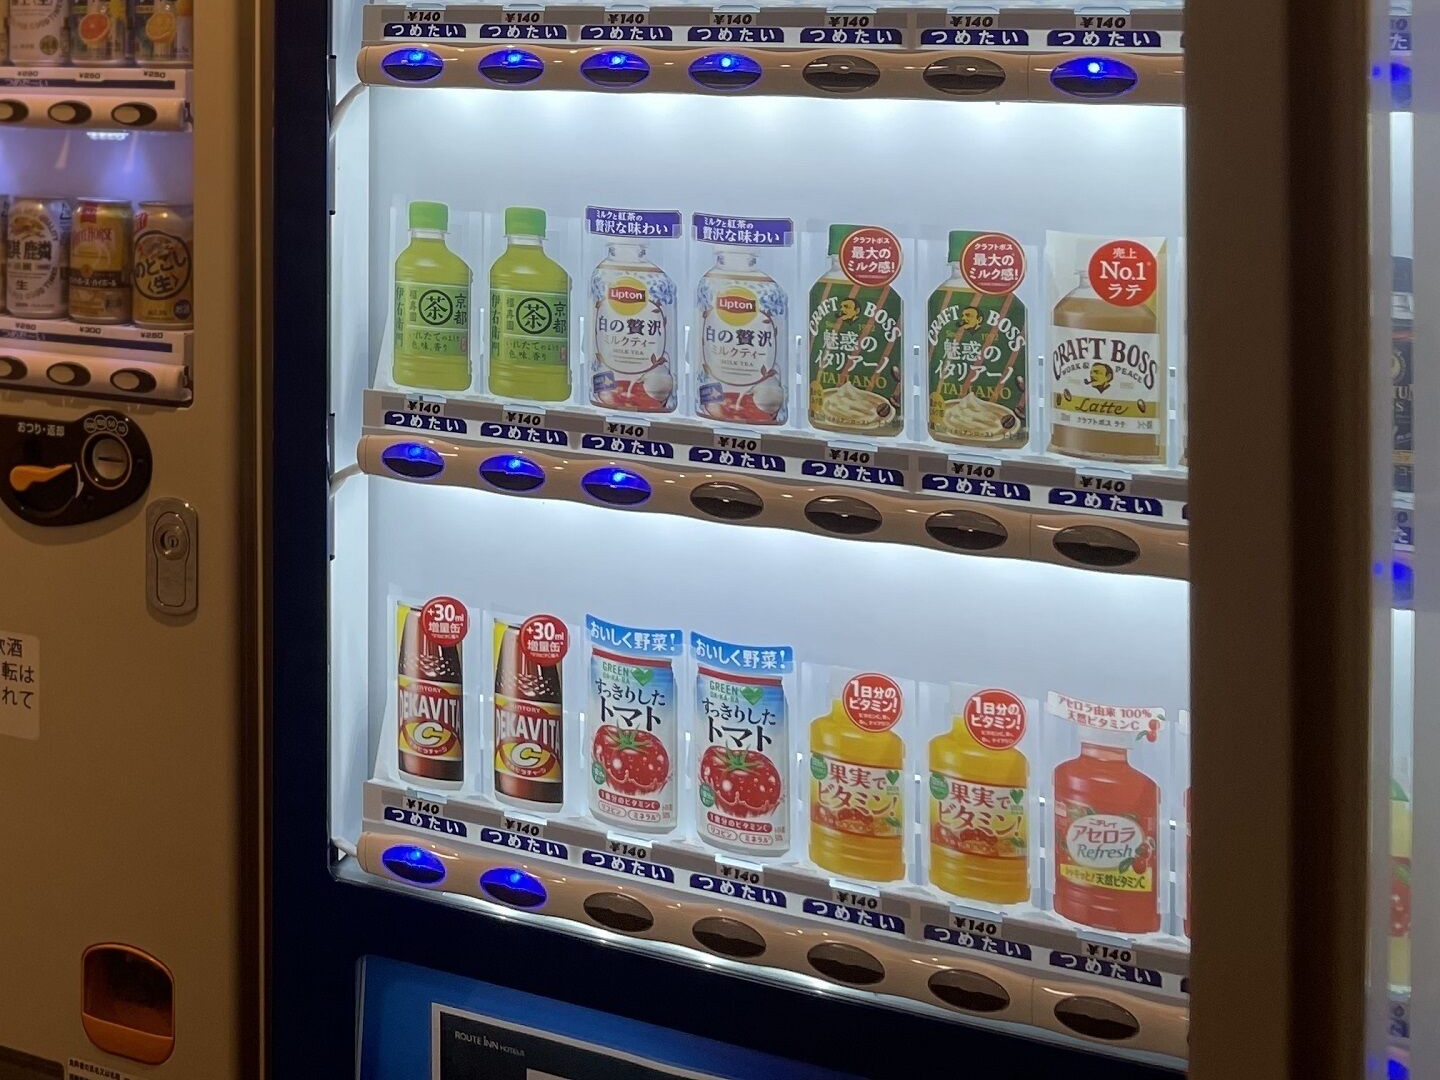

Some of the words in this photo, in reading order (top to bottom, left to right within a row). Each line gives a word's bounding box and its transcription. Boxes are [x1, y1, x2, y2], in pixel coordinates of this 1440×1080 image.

[407, 12, 441, 22] ¥140
[505, 13, 540, 23] ¥140
[607, 13, 645, 24] ¥140
[713, 14, 753, 25] ¥140
[829, 16, 870, 27] ¥140
[950, 16, 994, 27] ¥140
[1080, 16, 1126, 28] ¥140
[391, 24, 460, 37] つめたい
[487, 25, 559, 39] つめたい
[589, 26, 664, 40] つめたい
[696, 28, 776, 41] つめたい
[809, 29, 893, 43] つめたい
[931, 30, 1019, 45] つめたい
[1057, 31, 1151, 47] つめたい
[596, 209, 643, 222] ミルクと紅茶の
[704, 216, 754, 230] ミルクと紅茶の
[595, 219, 668, 236] 贅沢な味わい
[703, 226, 780, 244] 贅沢な味わい
[852, 236, 890, 245] クラフトボス
[974, 242, 1013, 251] クラフトボス
[851, 246, 892, 260] 最大の
[972, 252, 1014, 267] 最大の
[1111, 247, 1137, 260] 売上
[847, 260, 896, 274] ミルク感!
[968, 267, 1019, 282] ミルク感!
[1099, 260, 1147, 282] No.1
[610, 288, 643, 300] Lipton
[1107, 284, 1143, 301] ラテ
[453, 292, 468, 326] 京都
[718, 298, 754, 310] Lipton
[553, 300, 567, 334] 京都
[810, 296, 838, 337] CRAFT
[863, 301, 902, 343] BOSS
[598, 318, 662, 336] 白の贅沢
[705, 325, 773, 347] 白の贅沢
[927, 304, 959, 347] CRAFT
[985, 309, 1026, 353] BOSS
[822, 331, 878, 353] 魅惑の
[942, 338, 1002, 363] 魅惑の
[814, 349, 890, 374] イタリアーノ
[1052, 337, 1107, 381] CRAFT
[1110, 339, 1158, 391] BOSS
[934, 358, 1015, 385] イタリアーノ
[1115, 365, 1143, 384] PEACE
[408, 400, 441, 414] ¥140
[1075, 398, 1129, 415] Latte
[391, 412, 459, 432] つめたい
[506, 411, 541, 425] ¥140
[17, 421, 66, 437] おつり・返却
[488, 422, 560, 444] つめたい
[607, 422, 644, 437] ¥140
[590, 435, 665, 456] つめたい
[719, 435, 757, 451] ¥140
[697, 448, 777, 470] つめたい
[829, 448, 870, 464] ¥140
[810, 461, 895, 484] つめたい
[951, 461, 995, 478] ¥140
[931, 476, 1021, 499] つめたい
[1080, 475, 1125, 492] ¥140
[1058, 490, 1153, 514] つめたい
[589, 620, 676, 651] おいしく野菜!
[695, 638, 787, 670] おいしく野菜!
[602, 661, 630, 677] GREEN
[594, 678, 666, 706] すっきりした
[709, 680, 739, 695] GREEN
[849, 679, 896, 699] 1日分の
[601, 696, 662, 732] トマト
[702, 698, 777, 726] すっきりした
[849, 696, 898, 713] ビタミン!
[970, 696, 1020, 716] 1日分の
[1120, 707, 1153, 718] 100%
[970, 712, 1021, 731] ビタミン!
[413, 721, 444, 746] C
[708, 717, 773, 753] トマト
[511, 742, 543, 768] C
[829, 762, 887, 791] 果実で
[817, 780, 899, 817] ビタミン!
[950, 781, 1010, 810] 果実で
[406, 798, 440, 815] ¥140
[391, 808, 459, 834] つめたい
[505, 819, 540, 837] ¥140
[938, 800, 1023, 838] ビタミン!
[488, 829, 560, 856] つめたい
[1072, 823, 1136, 844] アセロラ
[610, 840, 647, 859] ¥140
[1076, 842, 1133, 860] Refresh
[591, 852, 667, 879] つめたい
[721, 864, 760, 884] ¥140
[698, 876, 778, 905] つめたい
[836, 890, 878, 909] ¥140
[812, 900, 895, 930] つめたい
[953, 916, 997, 936] ¥140
[932, 927, 1022, 957] つめたい
[1086, 941, 1132, 963] ¥140
[1060, 953, 1153, 984] つめたい
[454, 1030, 481, 1046] ROUTE
